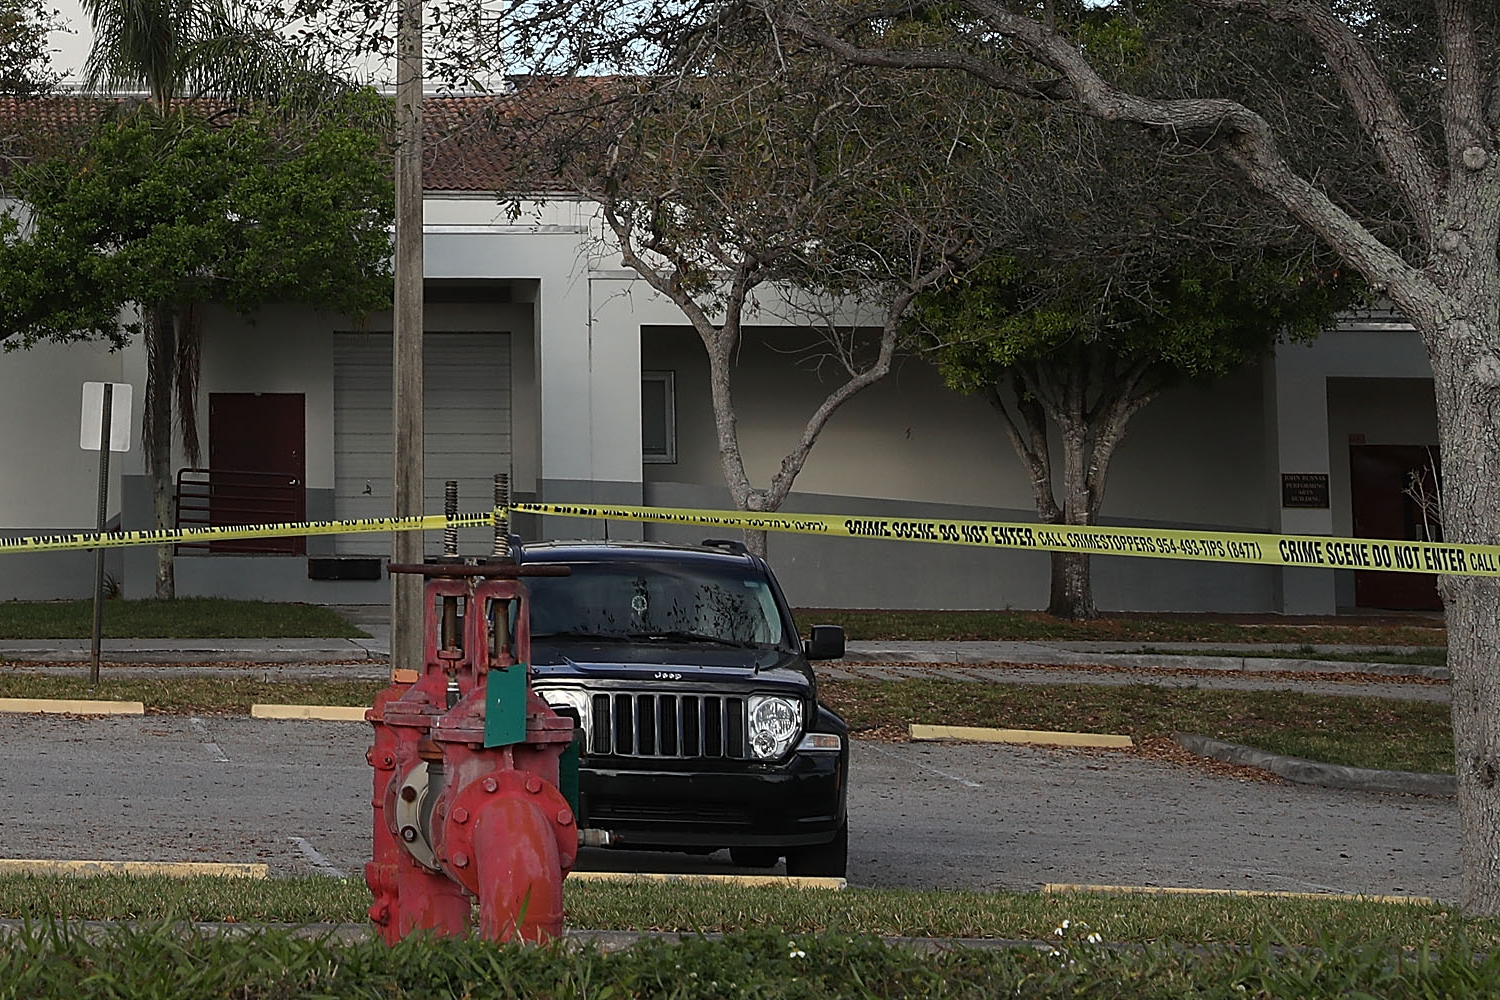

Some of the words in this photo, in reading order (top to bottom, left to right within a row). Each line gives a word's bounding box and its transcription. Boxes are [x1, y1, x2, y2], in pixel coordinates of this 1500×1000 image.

[845, 519, 891, 537] CRIME
[892, 521, 938, 540] SCENE
[938, 524, 960, 542] DO
[961, 525, 989, 543] NOT
[991, 526, 1037, 547] ENTER
[1038, 531, 1067, 547] CALL
[1066, 533, 1156, 553] CRIMESTOPPERS
[1156, 537, 1226, 557] 954-493-TIPS
[1227, 541, 1262, 560] (8477)
[1279, 539, 1324, 563] CRIME
[1326, 542, 1370, 566] SCENE
[1372, 544, 1392, 568] DO
[1394, 546, 1422, 570] NOT
[1424, 547, 1468, 572] ENTER
[1469, 552, 1498, 572] CALL
[654, 671, 682, 680] Jeep
